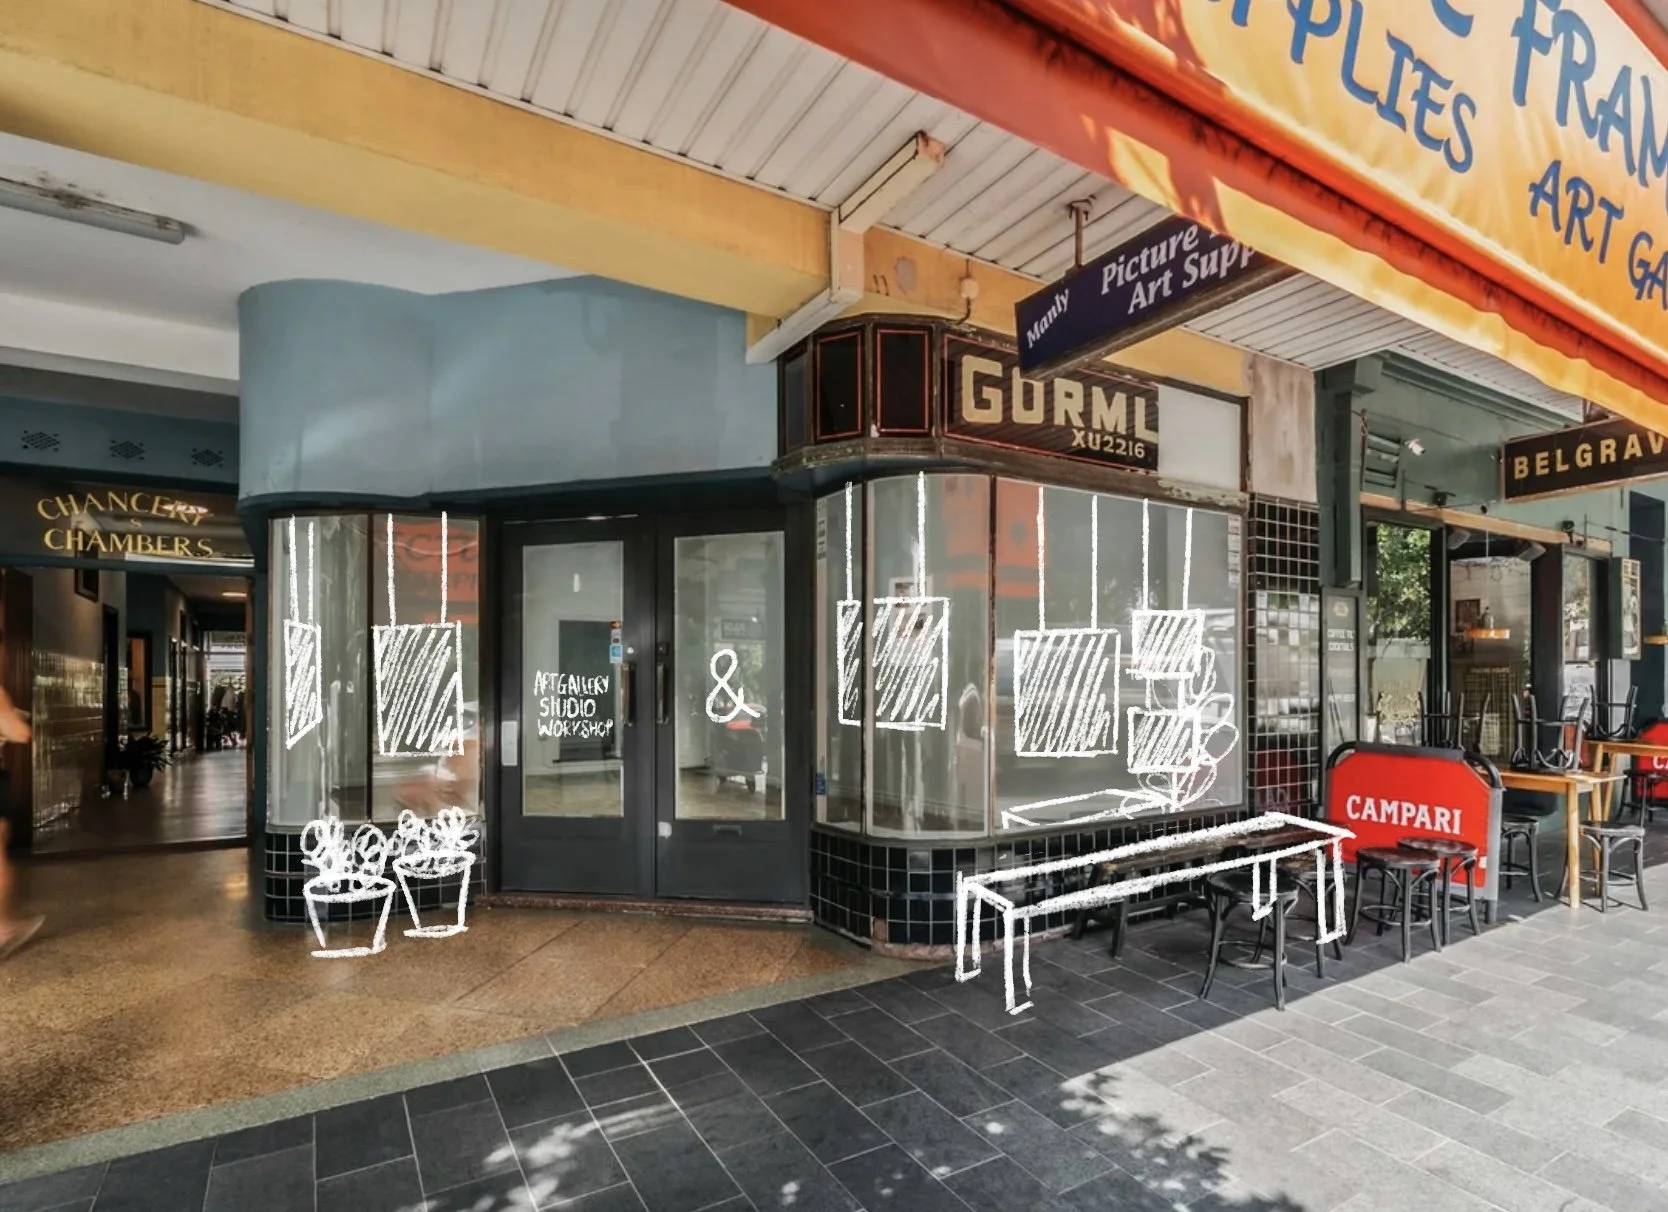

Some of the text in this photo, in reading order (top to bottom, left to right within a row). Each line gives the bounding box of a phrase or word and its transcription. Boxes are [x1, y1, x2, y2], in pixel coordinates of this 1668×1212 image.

[1528, 160, 1625, 265] ART
[1101, 224, 1200, 296] Picture
[1128, 271, 1174, 315] Art
[1026, 287, 1070, 349] Manly
[1071, 428, 1146, 459] XU2216
[1513, 430, 1665, 480] BELGRAV
[37, 491, 210, 527] CHANCERY
[44, 528, 214, 559] CHAMBERS
[1345, 794, 1463, 836] CAMPARI
